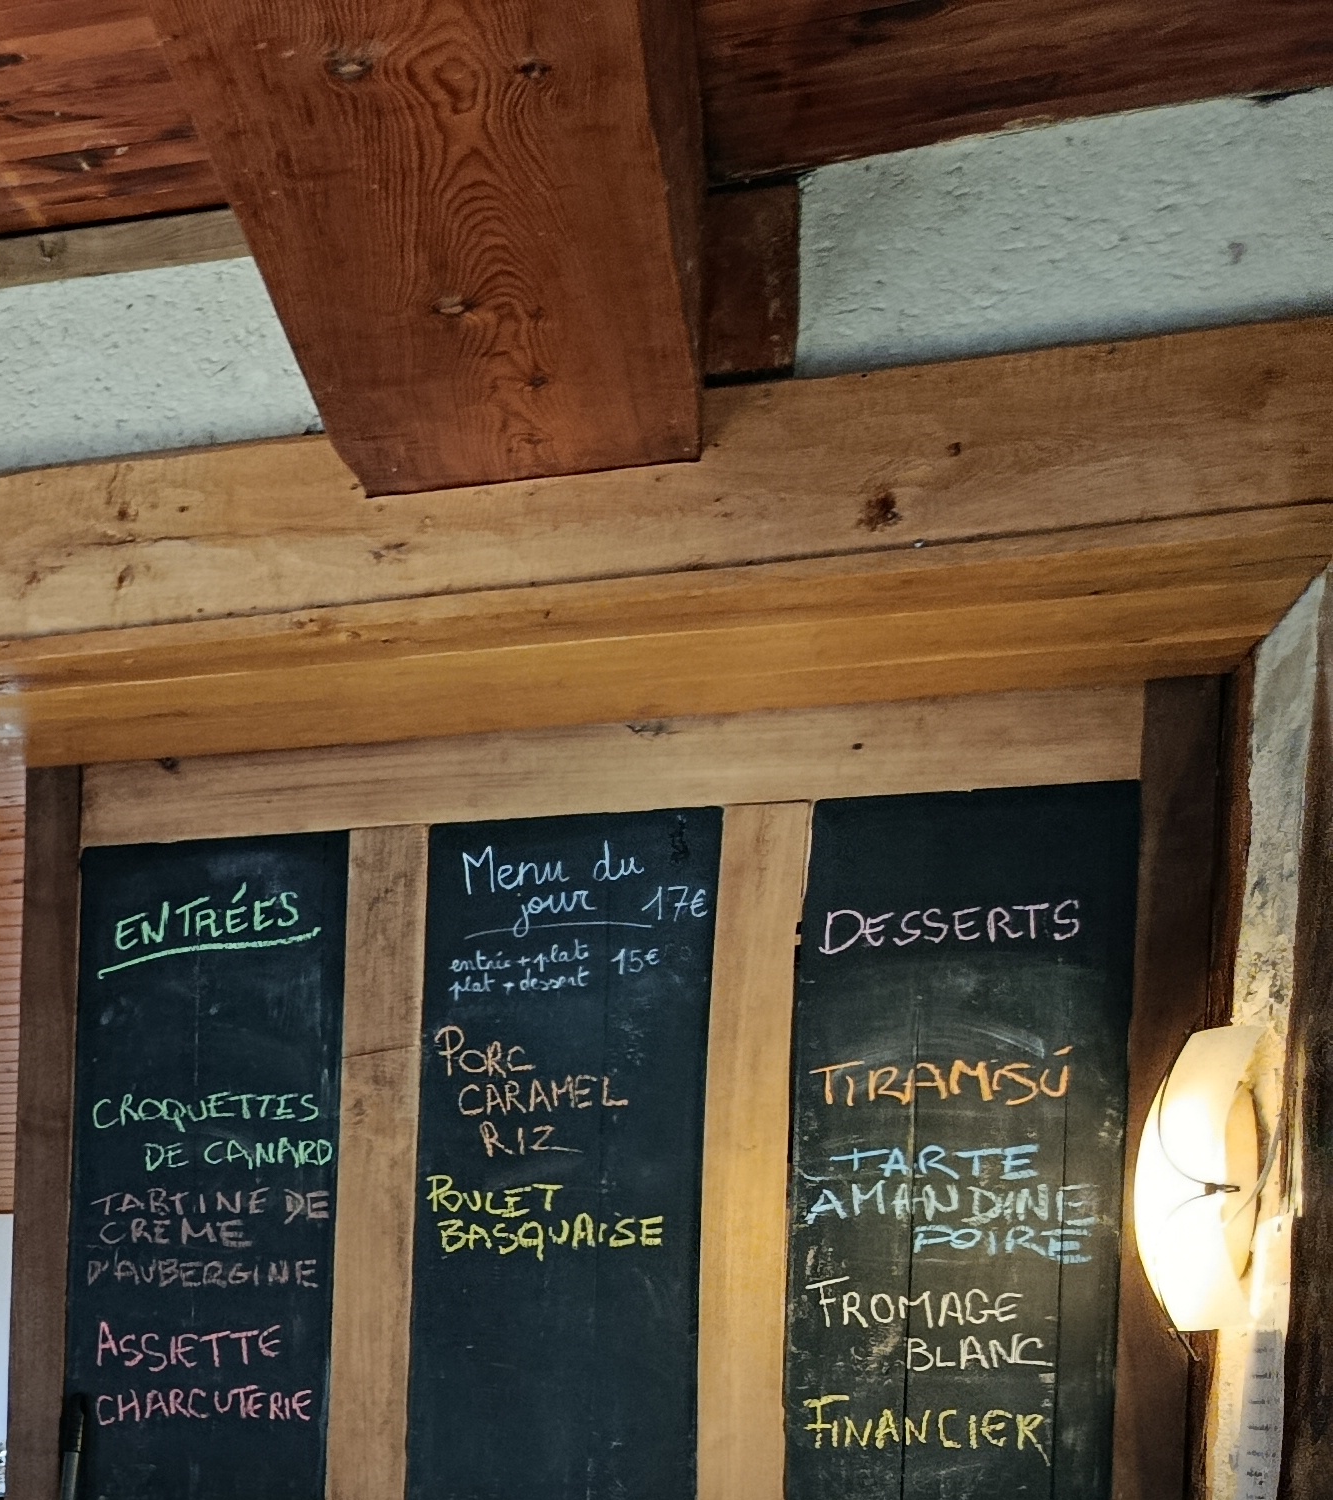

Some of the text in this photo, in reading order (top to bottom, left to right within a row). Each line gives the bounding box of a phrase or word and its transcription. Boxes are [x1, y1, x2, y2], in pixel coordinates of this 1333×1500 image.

[462, 841, 645, 895] Menu du
[114, 882, 300, 951] ENTRÉES
[512, 886, 709, 937] jour 17€
[817, 900, 1082, 955] DESSERTS
[610, 948, 661, 975] 15€
[448, 972, 496, 1001] plat
[435, 1025, 536, 1077] PORC
[92, 1092, 320, 1133] CROQUETTES
[458, 1075, 629, 1116] CARAMEL
[144, 1137, 333, 1171] DE CANARD
[480, 1121, 583, 1158] RIZ
[829, 1144, 1041, 1180] TARTE
[91, 1187, 331, 1225] TARTINE DE
[426, 1174, 564, 1218] POULET
[804, 1180, 1099, 1225] AMANDINE
[436, 1212, 664, 1262] BASQUAISE
[912, 1225, 1093, 1265] POIRE
[88, 1258, 319, 1288] D'AUBERGINE
[804, 1276, 1024, 1328] FROMAGE
[95, 1321, 281, 1371] ASSIETTE
[904, 1333, 1055, 1372] BLANC
[96, 1388, 313, 1425] CHARCUTERIE
[803, 1395, 1051, 1467] FINANCIER
